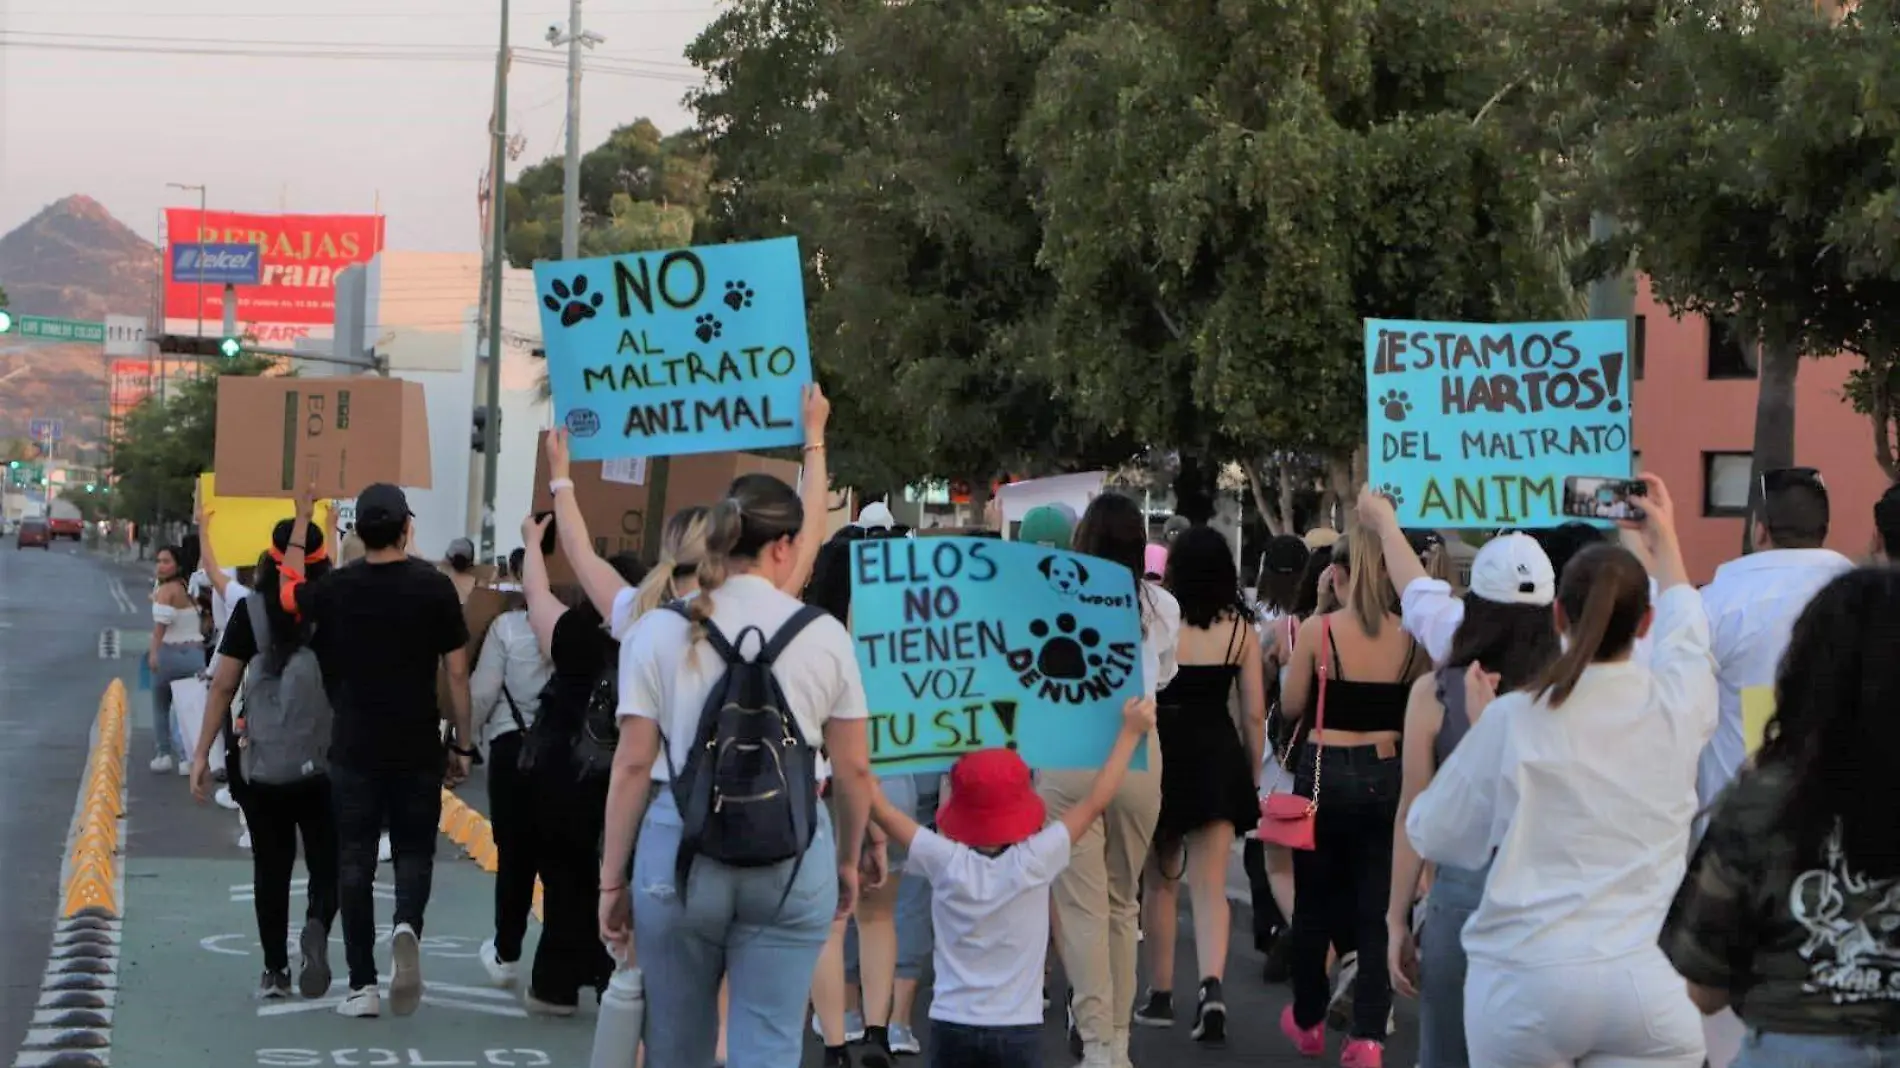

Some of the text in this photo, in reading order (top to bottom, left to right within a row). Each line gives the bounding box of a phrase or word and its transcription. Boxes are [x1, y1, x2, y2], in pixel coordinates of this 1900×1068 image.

[197, 228, 359, 260] REBAJAS
[614, 250, 706, 317] NO
[617, 329, 664, 354] AL
[1373, 328, 1580, 374] ¡ESTAMOS
[583, 346, 795, 392] MALTRATO
[1441, 352, 1623, 414] HARTOS!
[624, 396, 793, 437] ANIMAL
[1382, 424, 1626, 462] DEL MALTRATO
[1419, 476, 1559, 523] ANIM
[858, 541, 998, 584] ELLOS
[903, 585, 960, 622] NO
[858, 620, 1007, 667] TIENEN
[902, 667, 985, 699] VOZ
[1006, 642, 1136, 704] DENUNCIA
[868, 713, 915, 752] TU
[256, 1048, 551, 1066] SOLO
